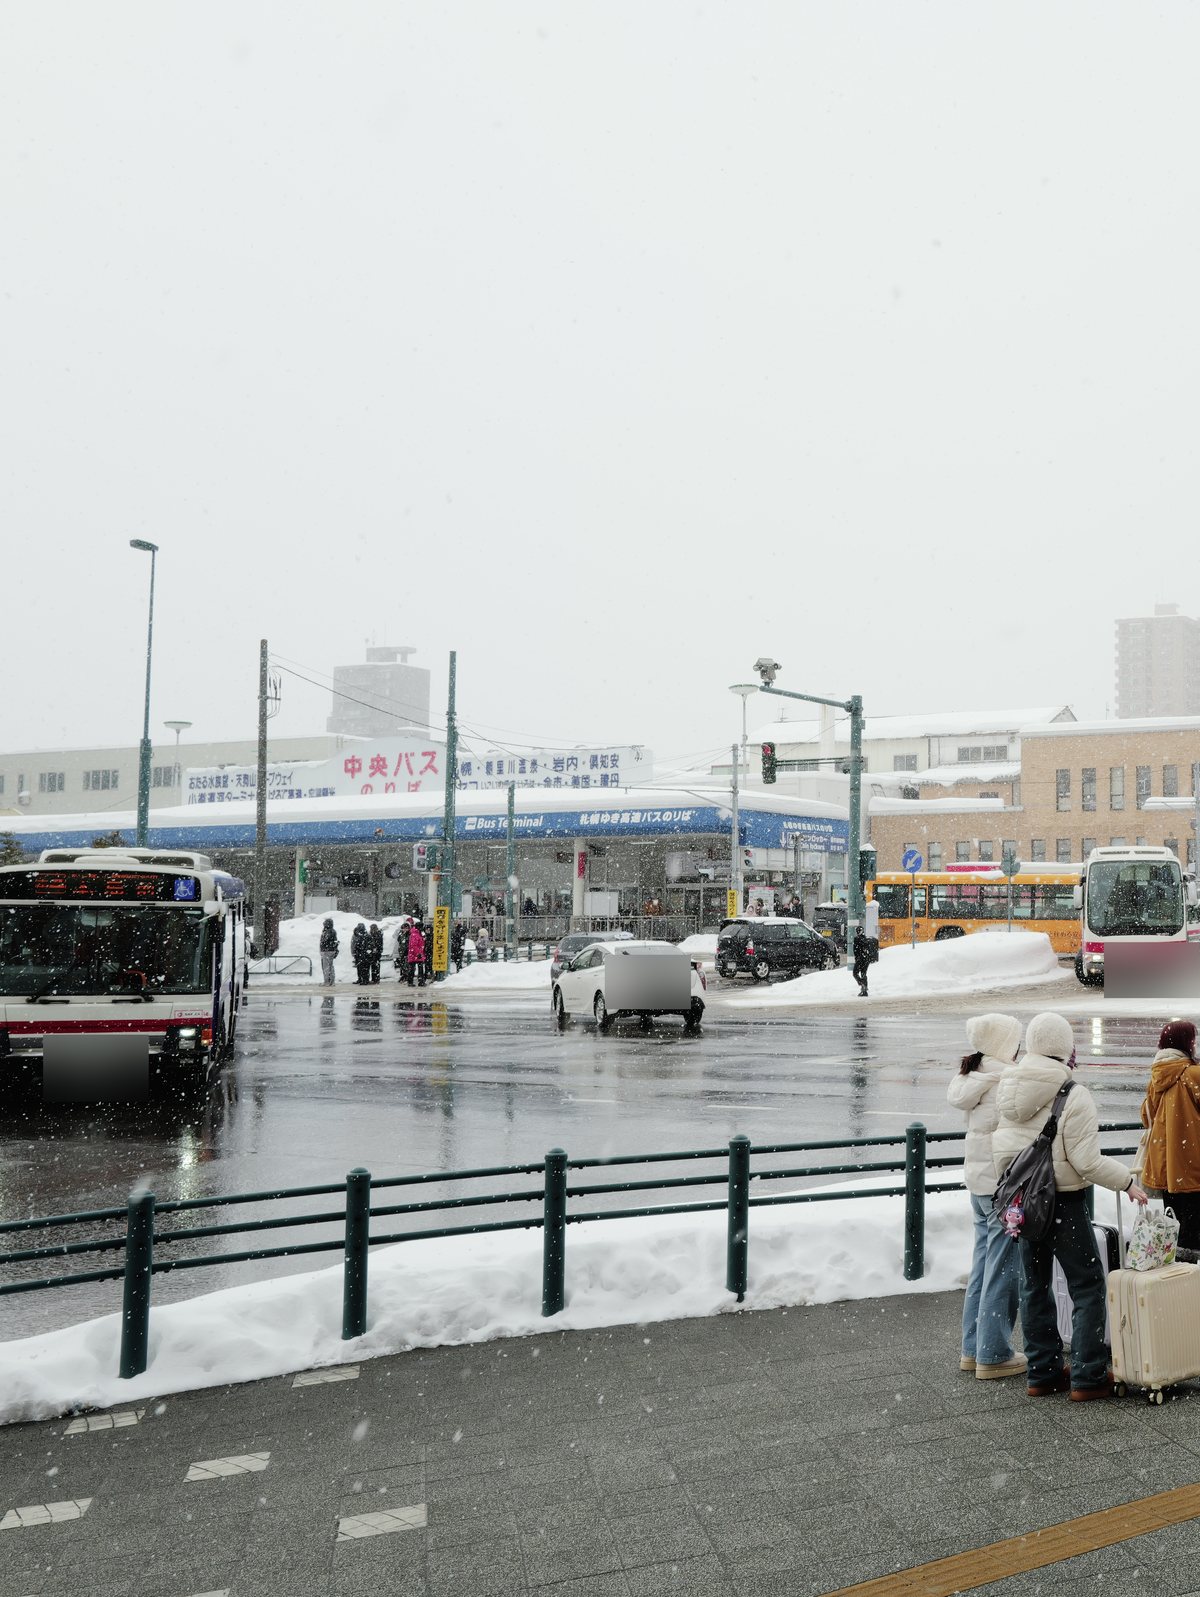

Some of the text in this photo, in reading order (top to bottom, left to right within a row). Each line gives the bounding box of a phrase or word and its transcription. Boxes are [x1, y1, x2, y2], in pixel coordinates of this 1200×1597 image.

[344, 751, 439, 779] 中央バス
[456, 753, 619, 776] 幌・朝里川温泉・岩内・倶知安
[360, 780, 421, 794] のりば
[476, 815, 544, 829] Bus Teminal
[580, 809, 697, 825] 札幌ゆき高速バスのりば
